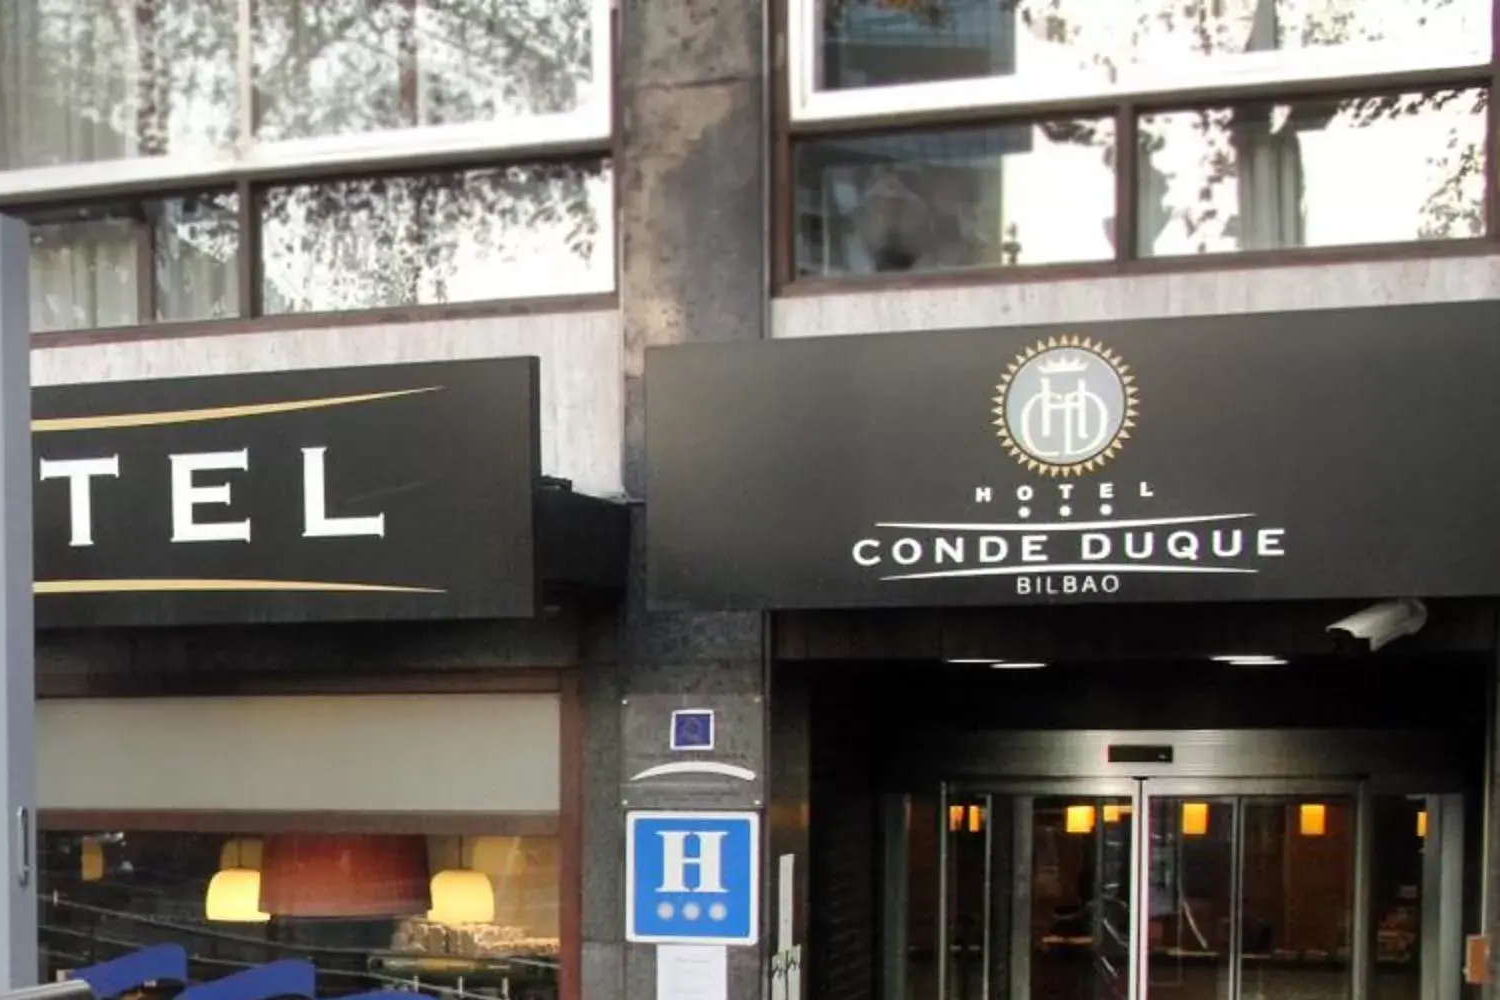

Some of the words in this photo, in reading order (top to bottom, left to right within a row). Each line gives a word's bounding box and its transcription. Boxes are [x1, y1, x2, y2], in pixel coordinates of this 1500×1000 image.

[39, 446, 386, 547] TEL
[975, 481, 1155, 503] HOTEL
[851, 534, 1049, 566] CONDE
[1081, 528, 1286, 561] DUQUE
[1016, 574, 1120, 595] BILBAO
[655, 831, 729, 893] H
